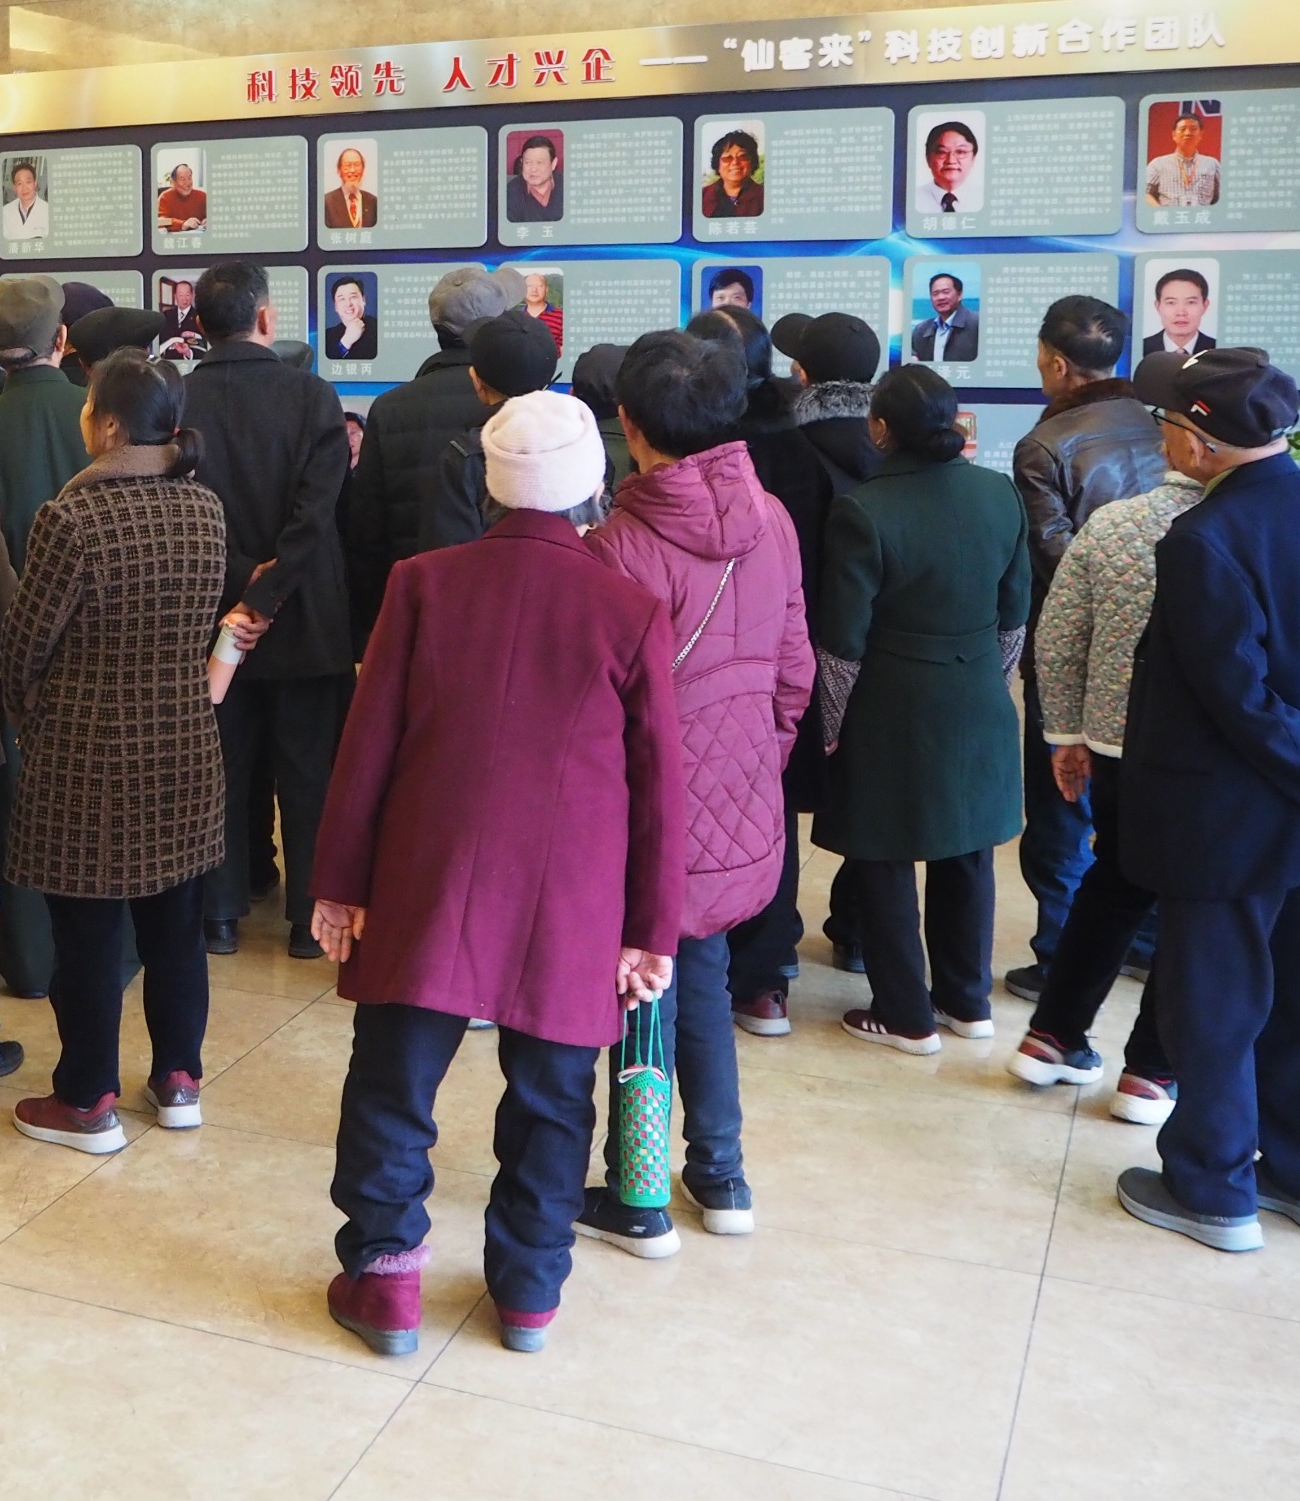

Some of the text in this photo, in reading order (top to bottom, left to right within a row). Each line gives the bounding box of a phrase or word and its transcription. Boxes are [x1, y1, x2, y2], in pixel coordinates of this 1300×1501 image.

[247, 61, 406, 104] 科技领先
[443, 47, 617, 92] 人才兴企
[922, 216, 977, 231] 胡德仁
[330, 231, 373, 245] 张树庭
[331, 363, 373, 376] 边银丙
